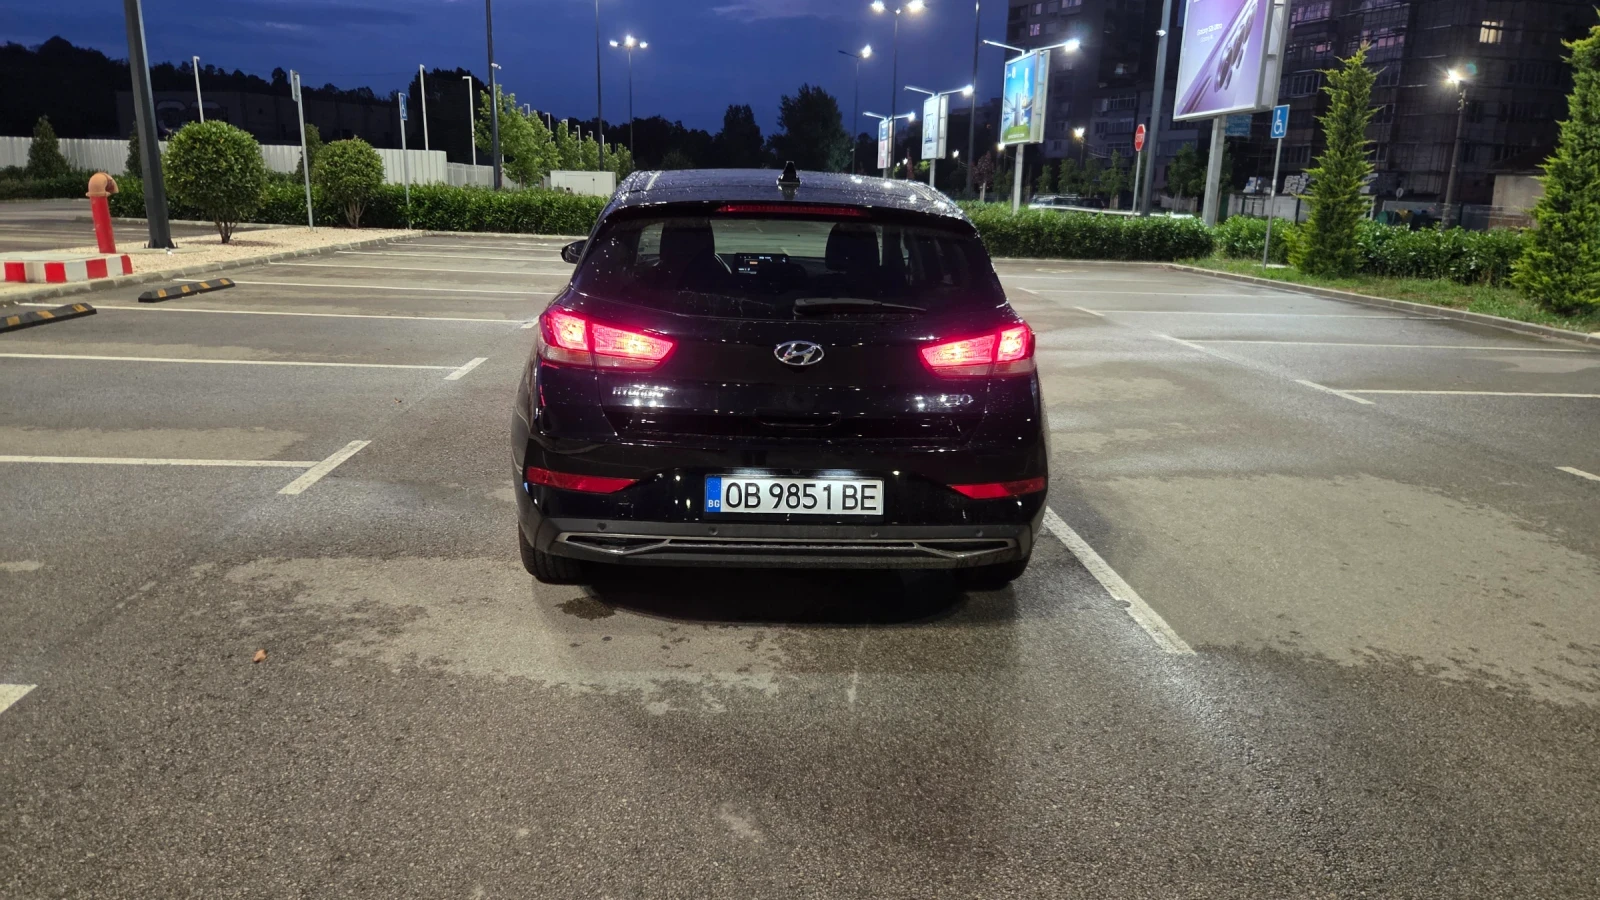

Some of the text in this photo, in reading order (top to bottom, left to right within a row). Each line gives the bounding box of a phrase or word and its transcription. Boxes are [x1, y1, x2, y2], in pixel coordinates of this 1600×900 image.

[708, 500, 720, 508] BG
[725, 482, 878, 511] OB 9851 BE
